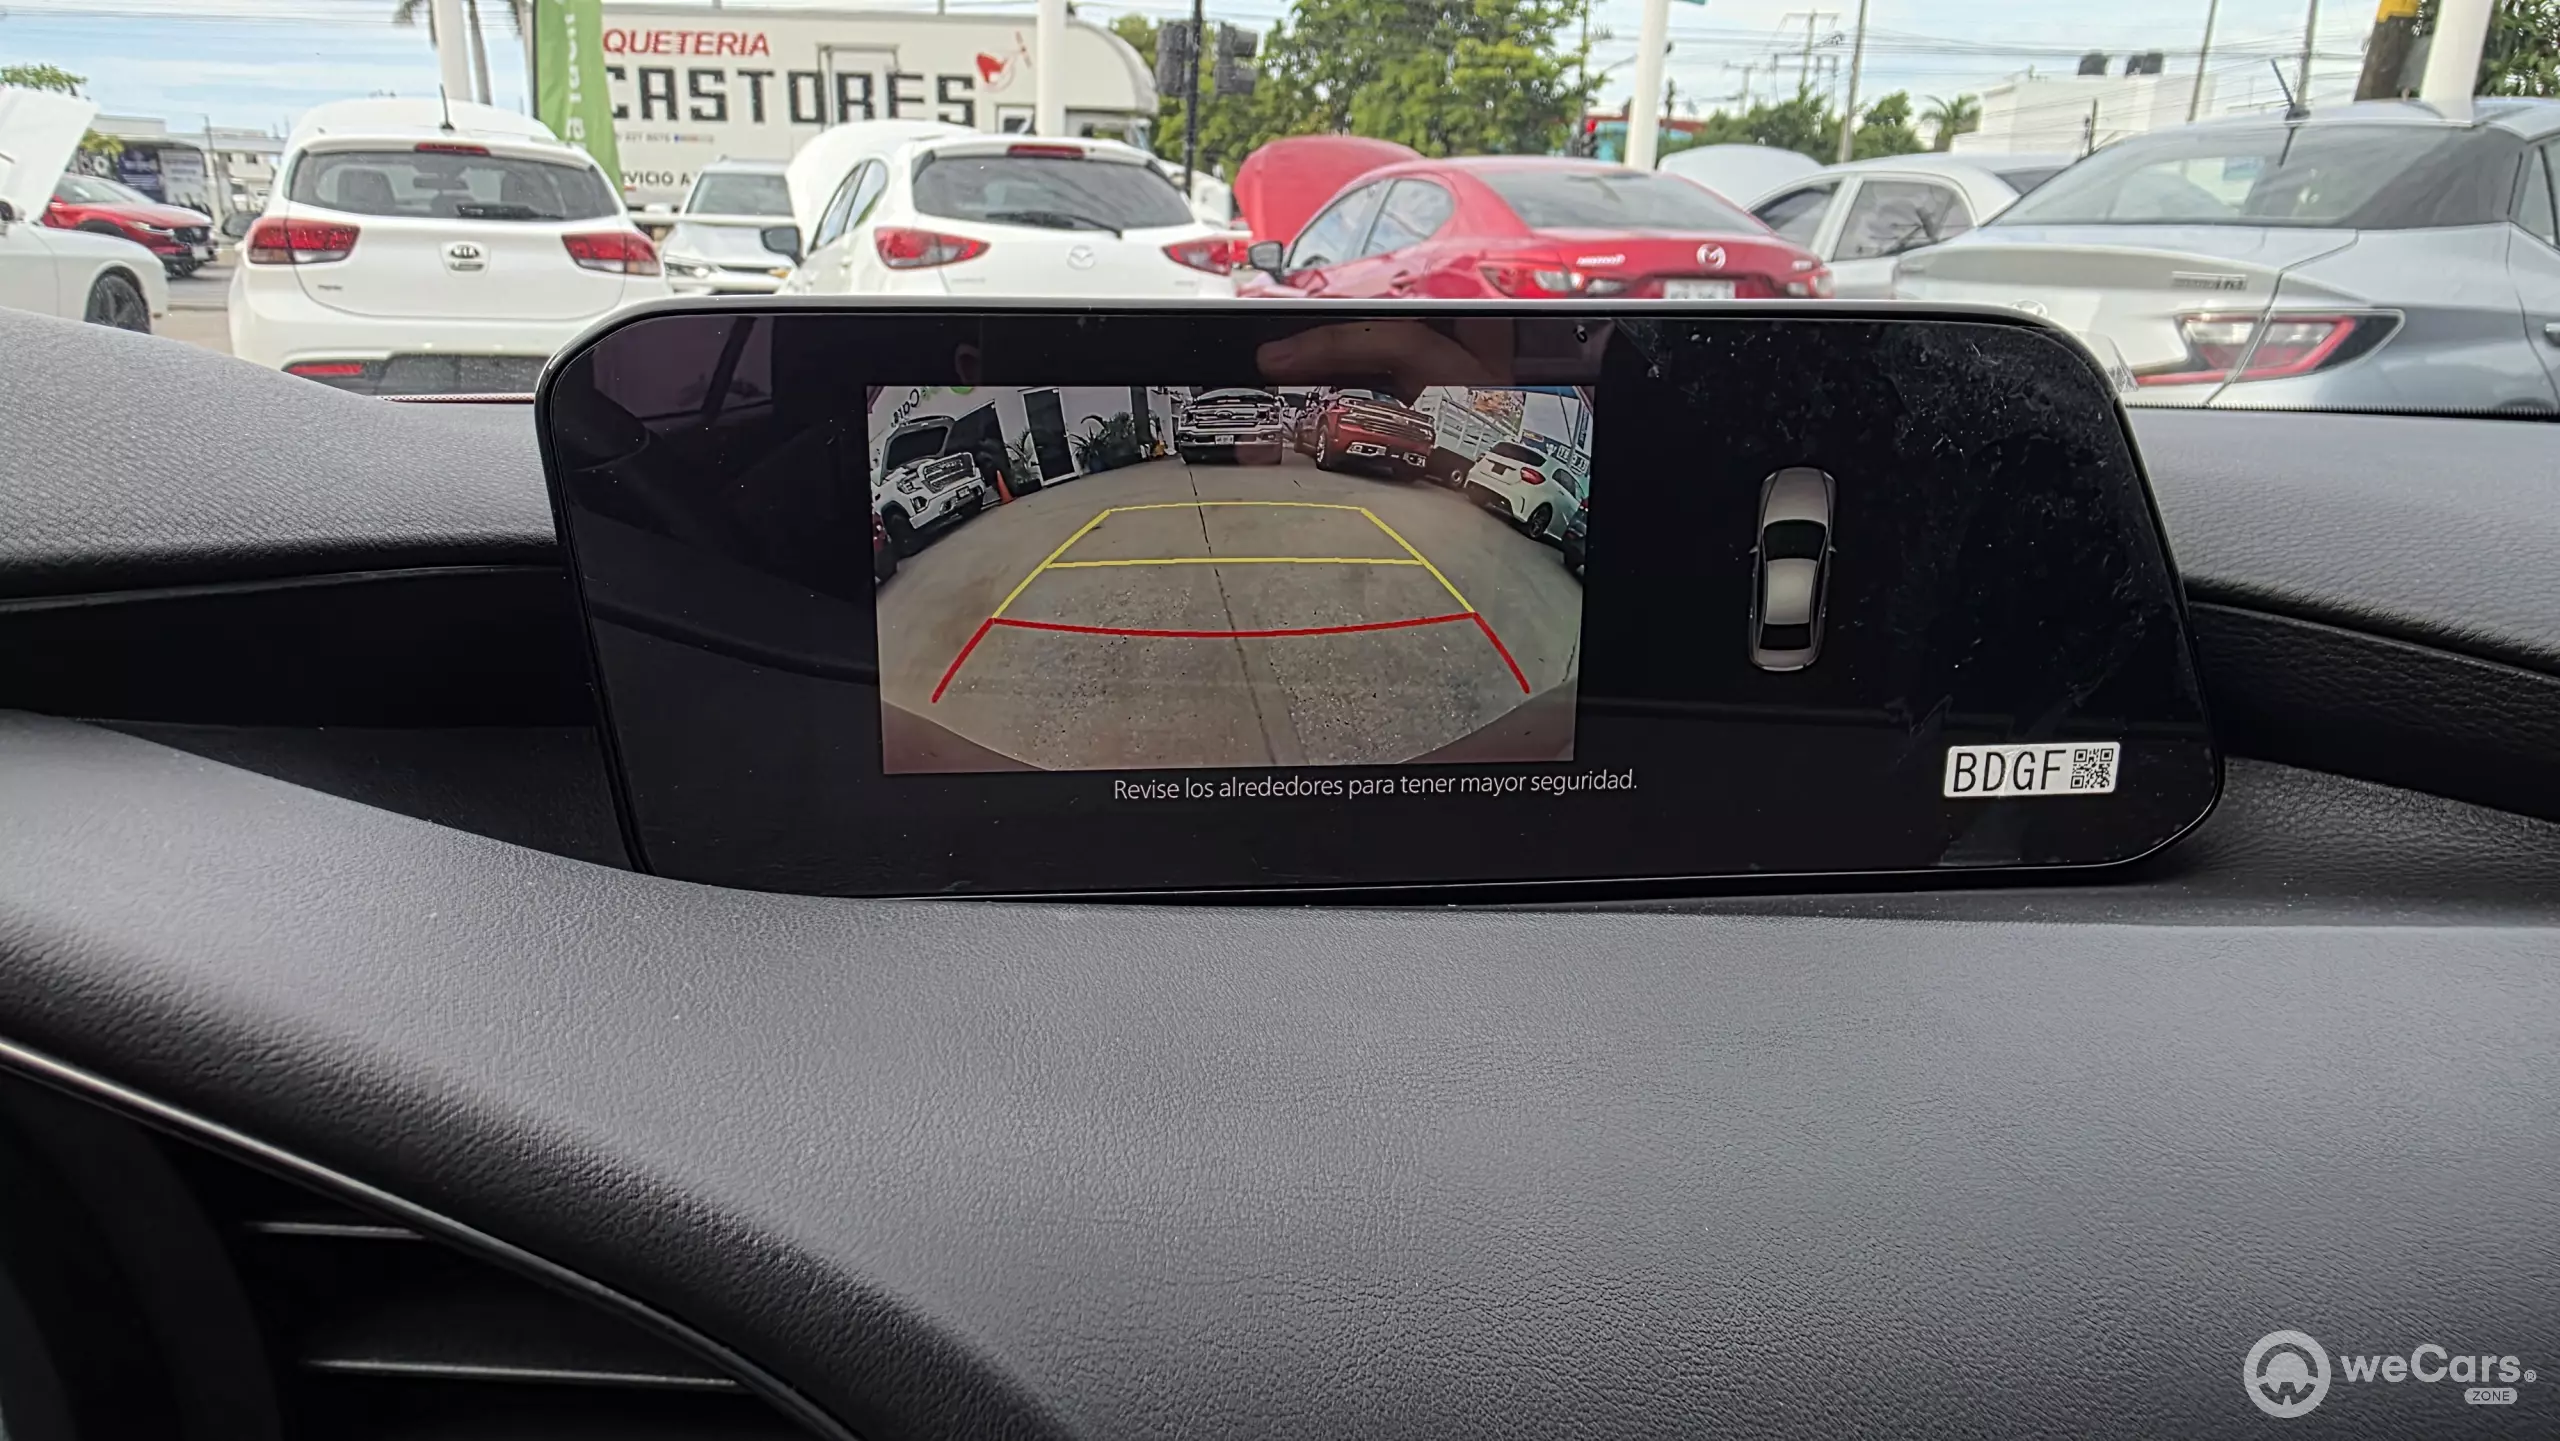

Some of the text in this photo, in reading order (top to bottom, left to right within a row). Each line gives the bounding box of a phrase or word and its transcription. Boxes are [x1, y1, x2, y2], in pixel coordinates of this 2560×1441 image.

[603, 29, 770, 57] QUETERIA
[622, 171, 674, 187] VICIO
[1114, 769, 1637, 799] Revise los alrededores para tener mayor seguridad.
[1953, 750, 2067, 793] BDGF
